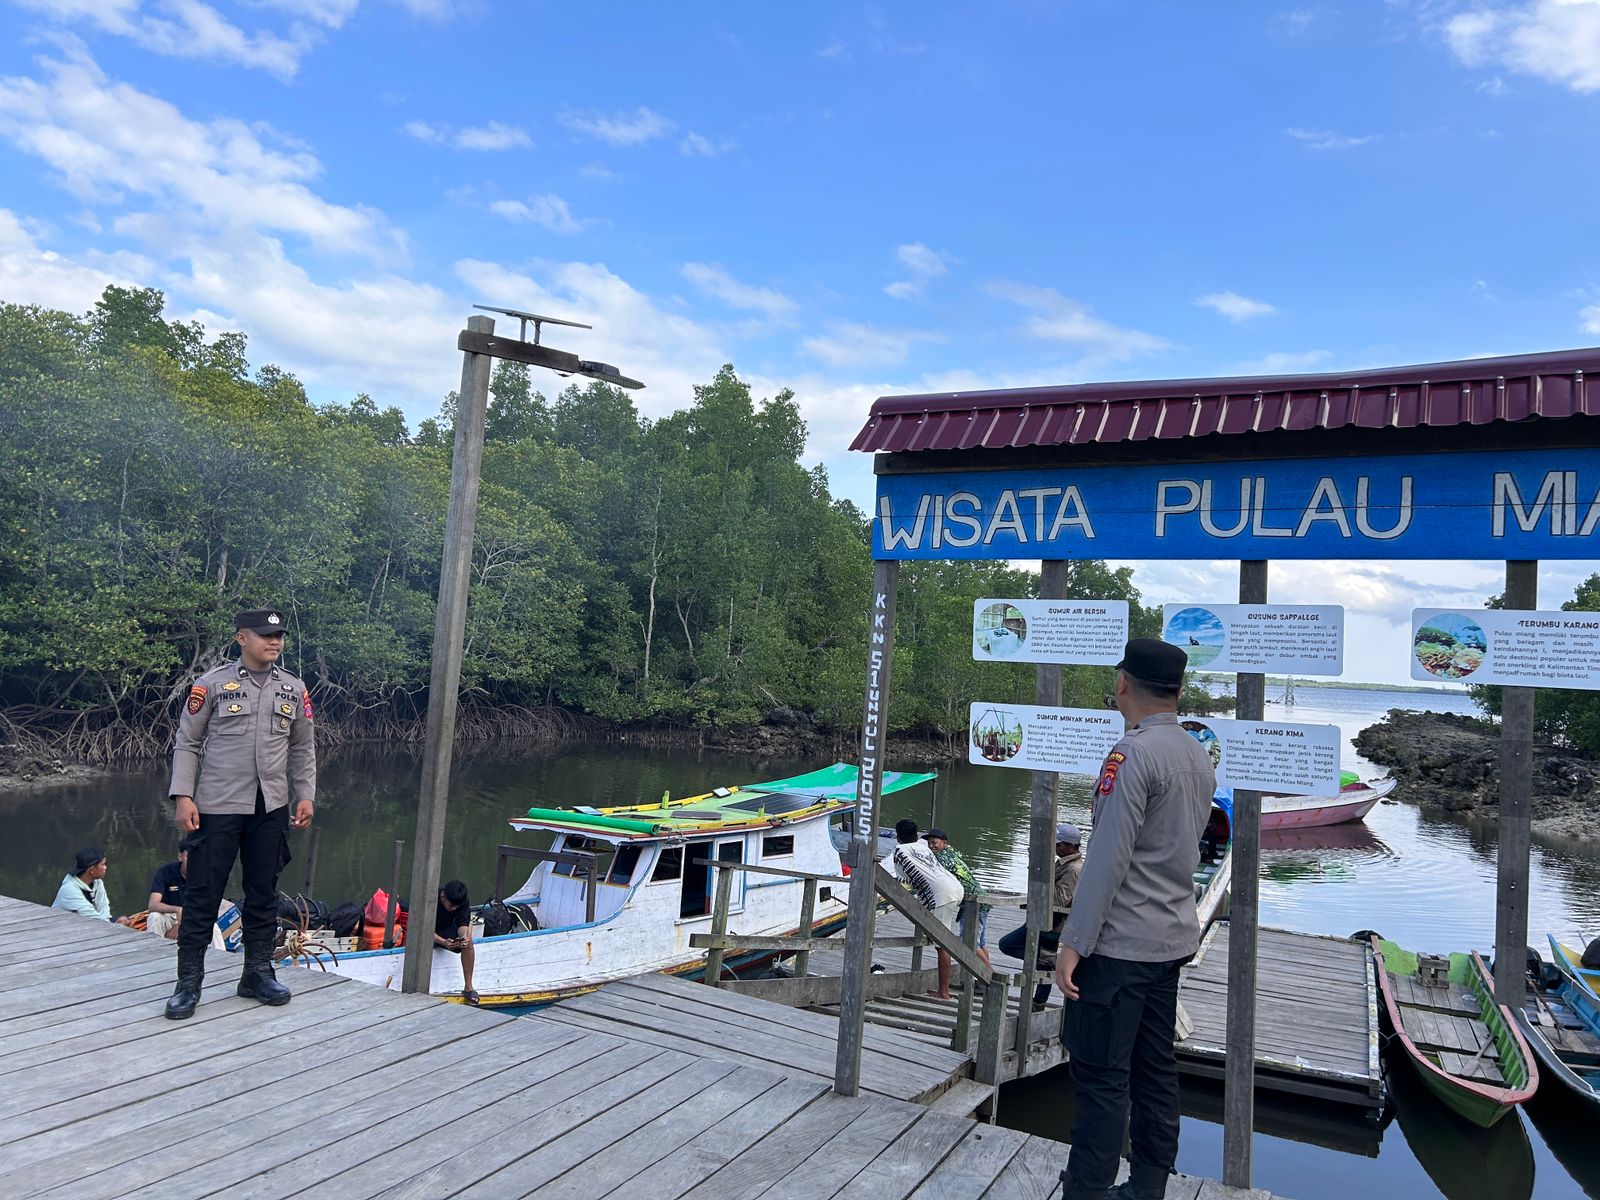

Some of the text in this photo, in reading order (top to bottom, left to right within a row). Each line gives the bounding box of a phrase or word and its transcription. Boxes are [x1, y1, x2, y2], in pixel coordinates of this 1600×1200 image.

[880, 485, 1095, 550] WISATA
[1155, 476, 1412, 539] PULAU
[1520, 620, 1560, 628] TERUMBU
[220, 692, 247, 700] INDRA
[275, 692, 297, 702] POLRI
